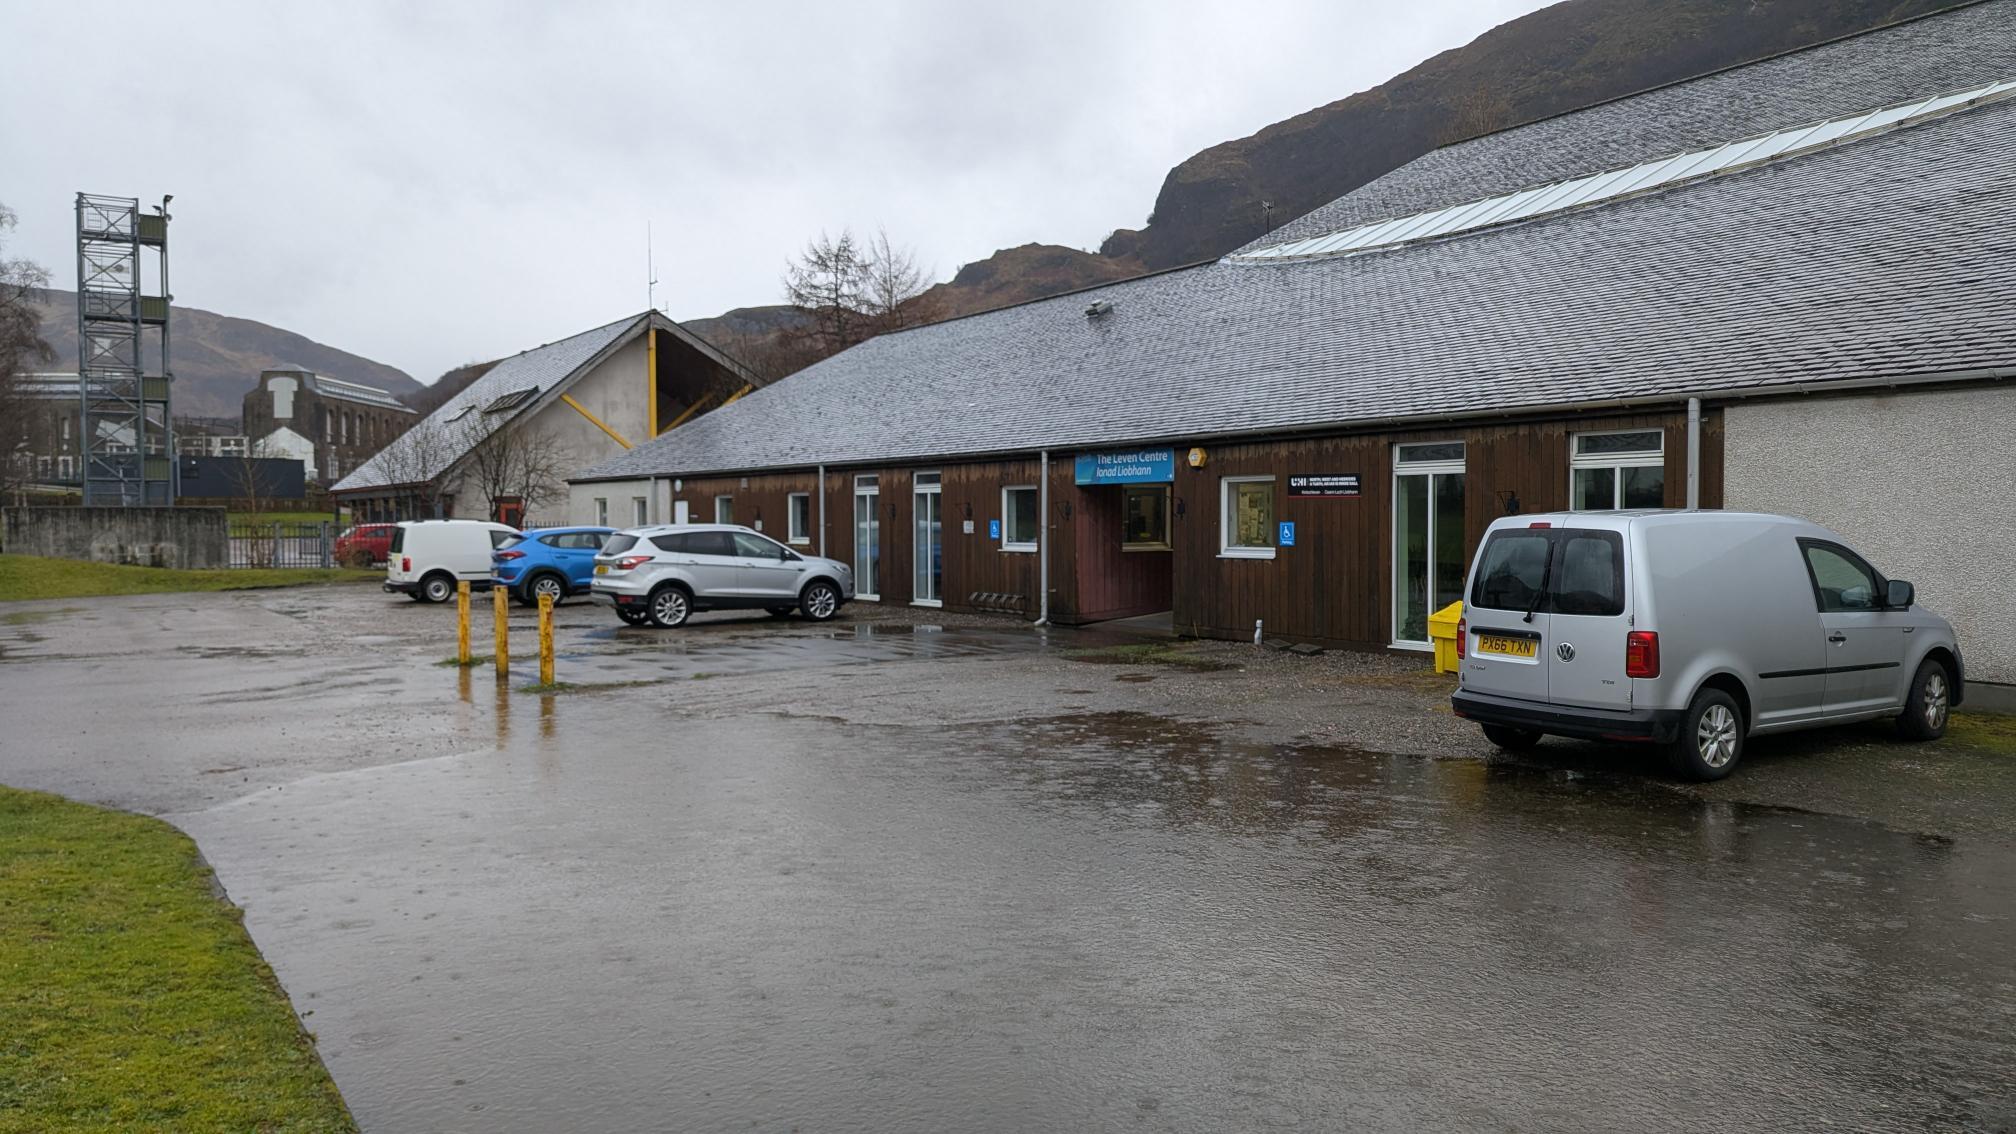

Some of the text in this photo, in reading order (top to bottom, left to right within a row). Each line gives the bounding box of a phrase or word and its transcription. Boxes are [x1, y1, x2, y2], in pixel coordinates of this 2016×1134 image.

[1097, 454, 1112, 464] The
[1113, 453, 1137, 463] Leven
[1139, 451, 1168, 462] Centre
[1096, 465, 1152, 477] Ionad Liobhann
[1481, 637, 1531, 654] PX66 TXN
